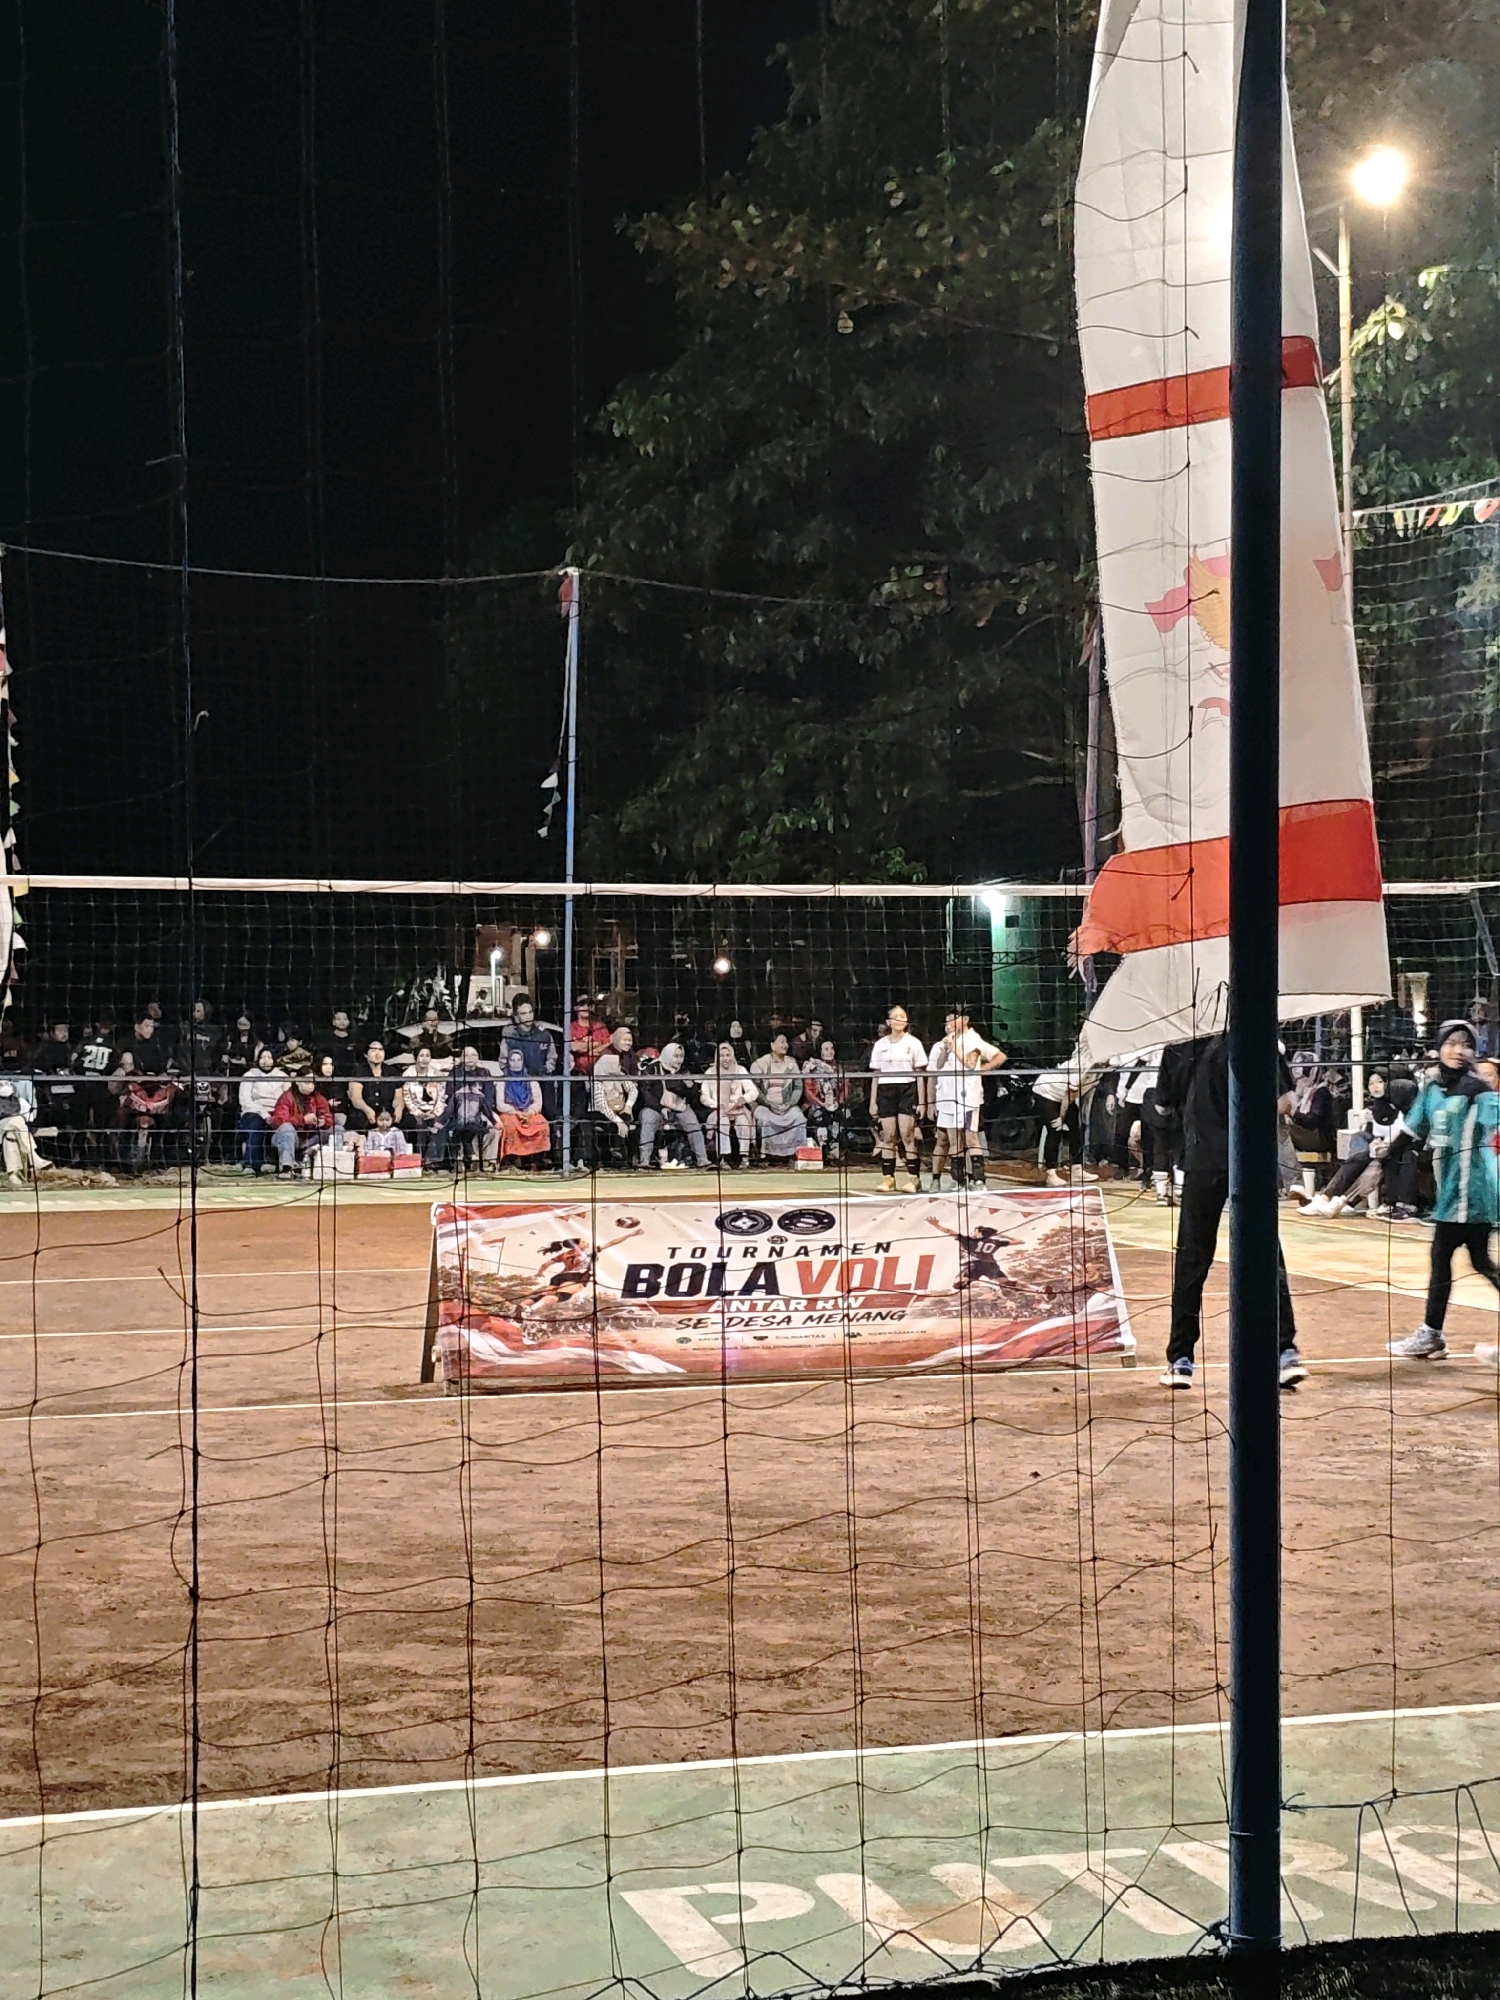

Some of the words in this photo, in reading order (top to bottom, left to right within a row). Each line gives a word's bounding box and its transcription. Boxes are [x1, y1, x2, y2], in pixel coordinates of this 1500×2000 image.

[83, 1045, 112, 1069] 20
[667, 1241, 892, 1259] TOURNAMEN
[974, 1241, 995, 1254] 10
[621, 1262, 780, 1298] BOLA
[796, 1254, 934, 1293] VOLI
[707, 1298, 805, 1313] ANTAR
[815, 1295, 865, 1310] RW
[675, 1313, 791, 1331] SE-DESA
[801, 1309, 907, 1325] MENANG
